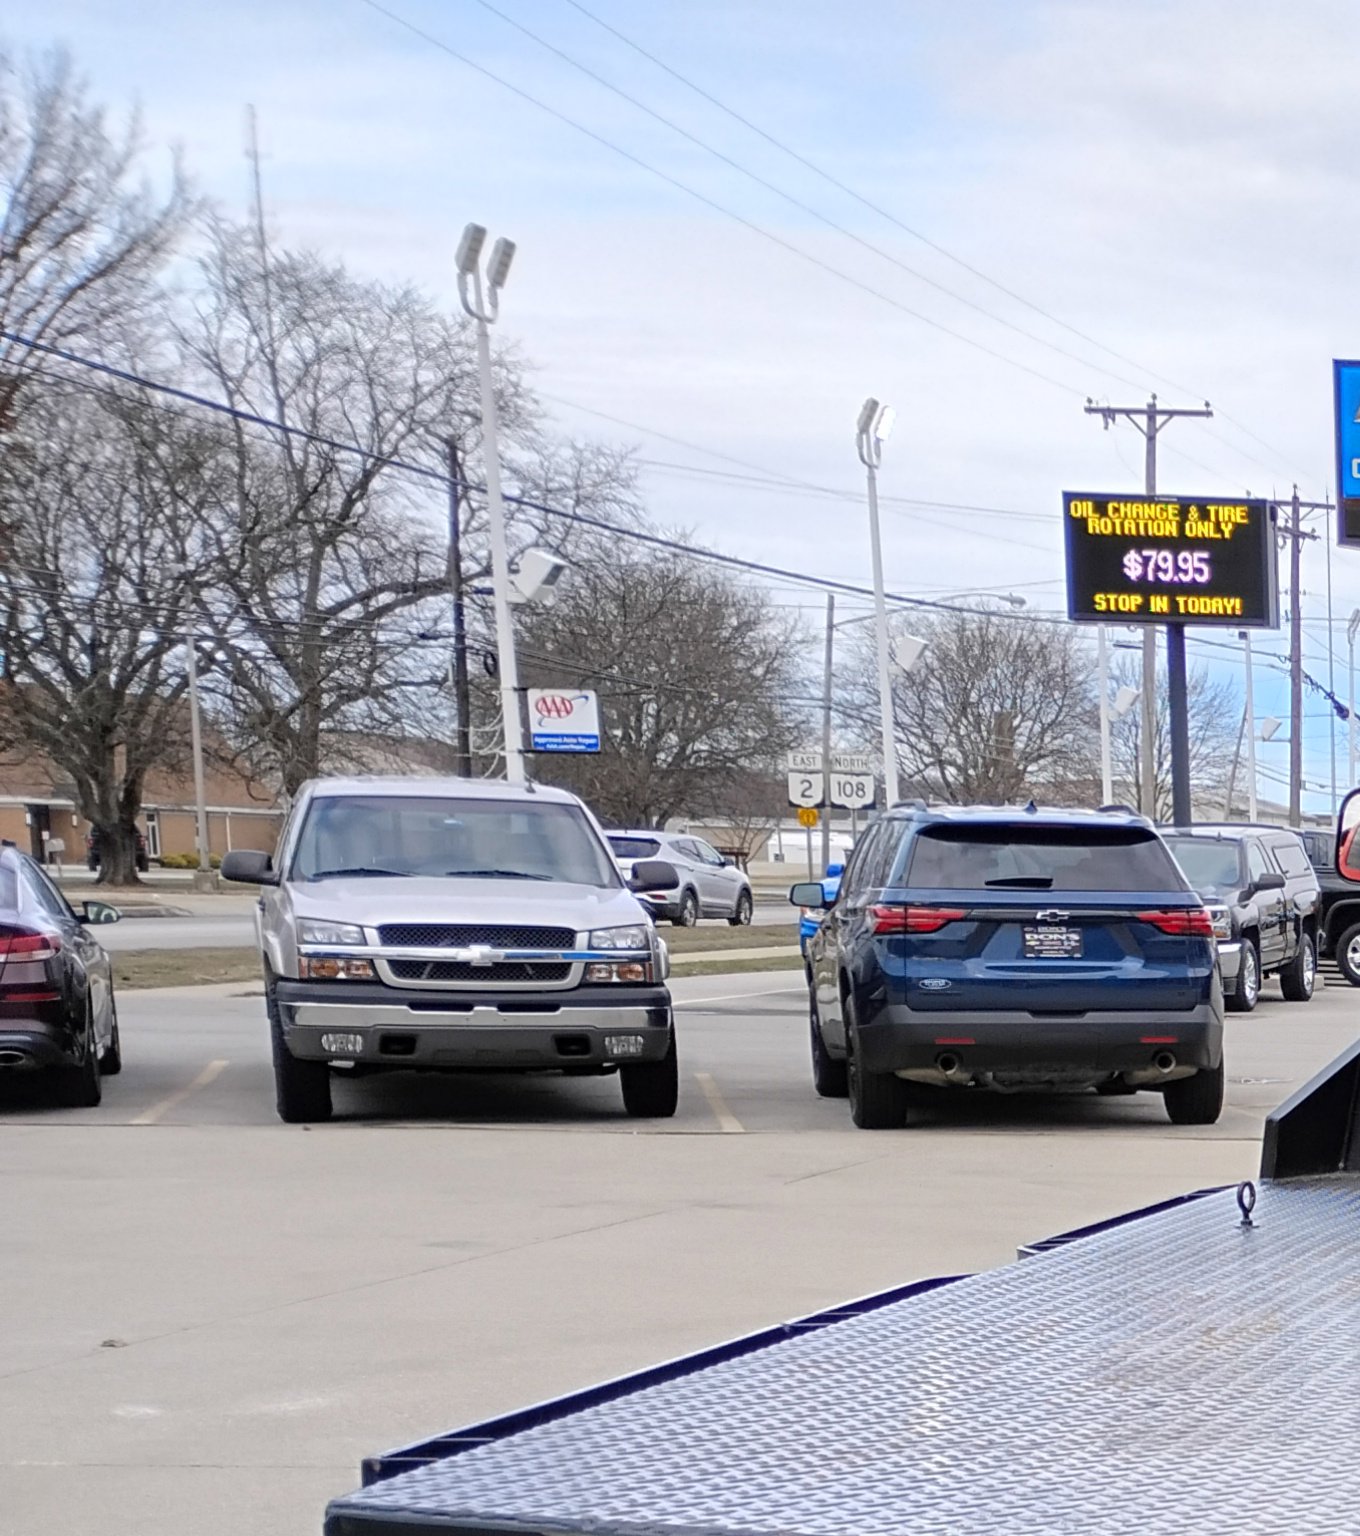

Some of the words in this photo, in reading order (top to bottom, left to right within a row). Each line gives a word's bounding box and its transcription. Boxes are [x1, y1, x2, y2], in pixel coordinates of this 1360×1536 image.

[1070, 501, 1098, 518] OIL
[1107, 503, 1180, 520] CHANGE
[1188, 506, 1198, 520] &
[1206, 505, 1249, 523] TIRE
[1087, 517, 1179, 537] ROTATION
[1185, 521, 1233, 539] ONLY
[1122, 549, 1211, 583] $79.95
[1093, 593, 1142, 613] STOP
[1149, 595, 1170, 614] IN
[1175, 596, 1243, 616] TODAY!
[539, 696, 571, 717] AAA
[793, 755, 817, 767] EAST
[835, 757, 868, 769] NORTH
[800, 779, 813, 799] 2
[837, 781, 866, 799] 108
